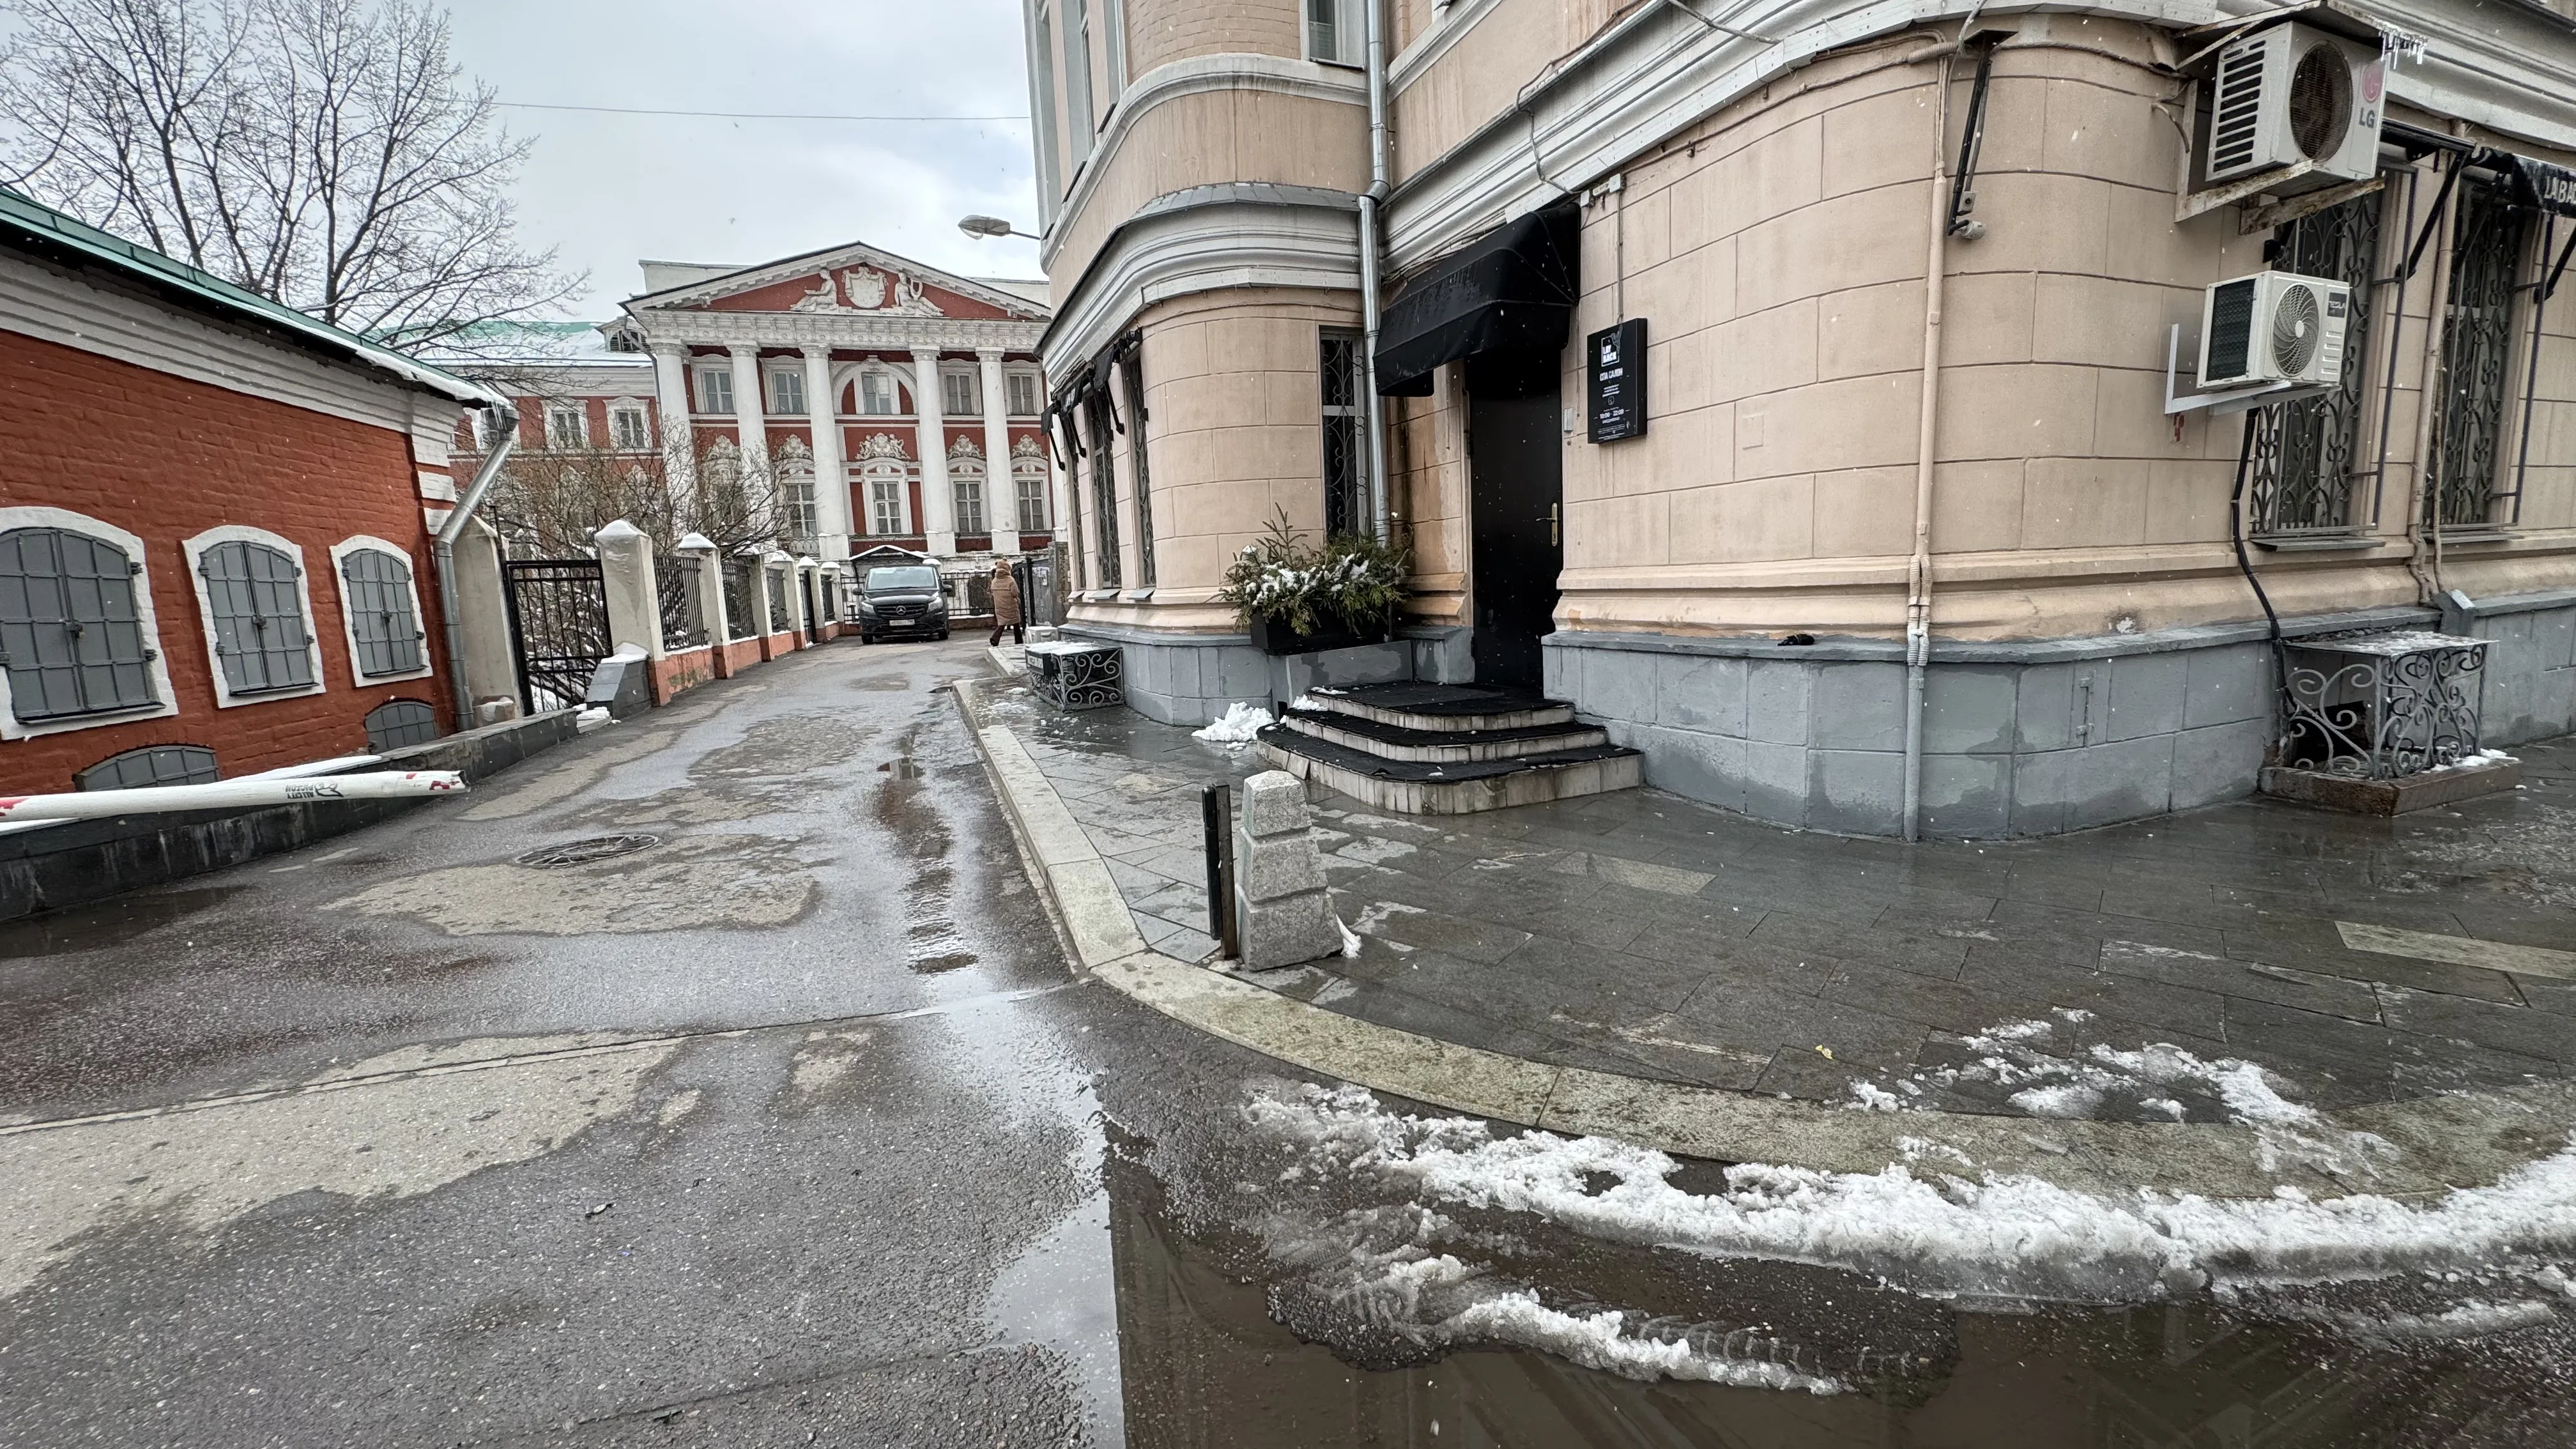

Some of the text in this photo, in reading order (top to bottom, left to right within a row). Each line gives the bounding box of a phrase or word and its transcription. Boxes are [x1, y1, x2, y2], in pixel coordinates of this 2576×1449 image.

[2359, 107, 2375, 128] LG
[1603, 344, 1611, 355] LAY
[1603, 351, 1617, 363] BACK
